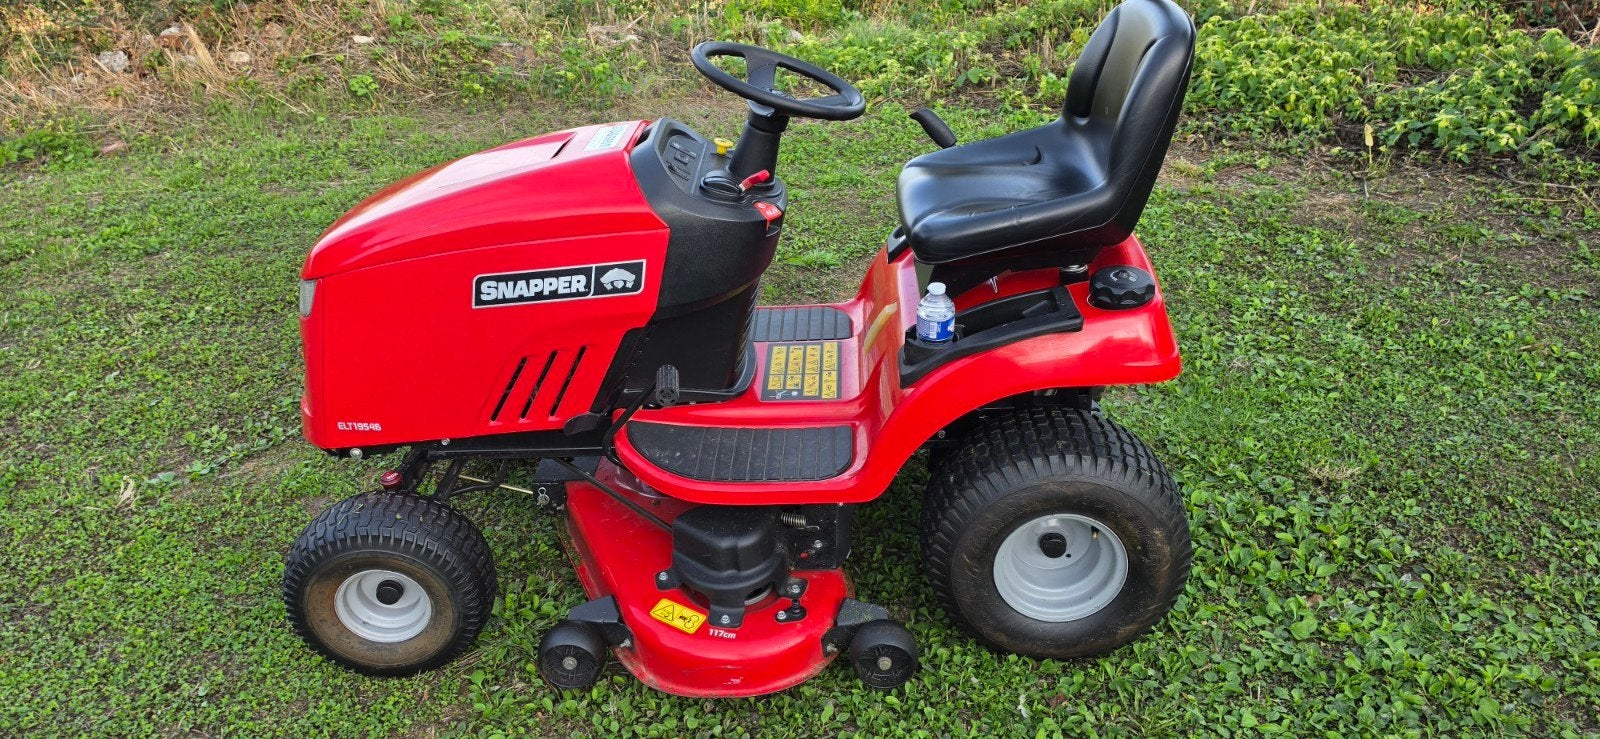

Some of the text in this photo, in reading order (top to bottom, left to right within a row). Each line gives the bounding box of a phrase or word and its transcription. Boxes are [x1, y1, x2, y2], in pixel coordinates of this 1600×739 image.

[480, 275, 587, 301] SNAPPER
[337, 422, 382, 431] ELT19546
[709, 628, 736, 639] 117cm
